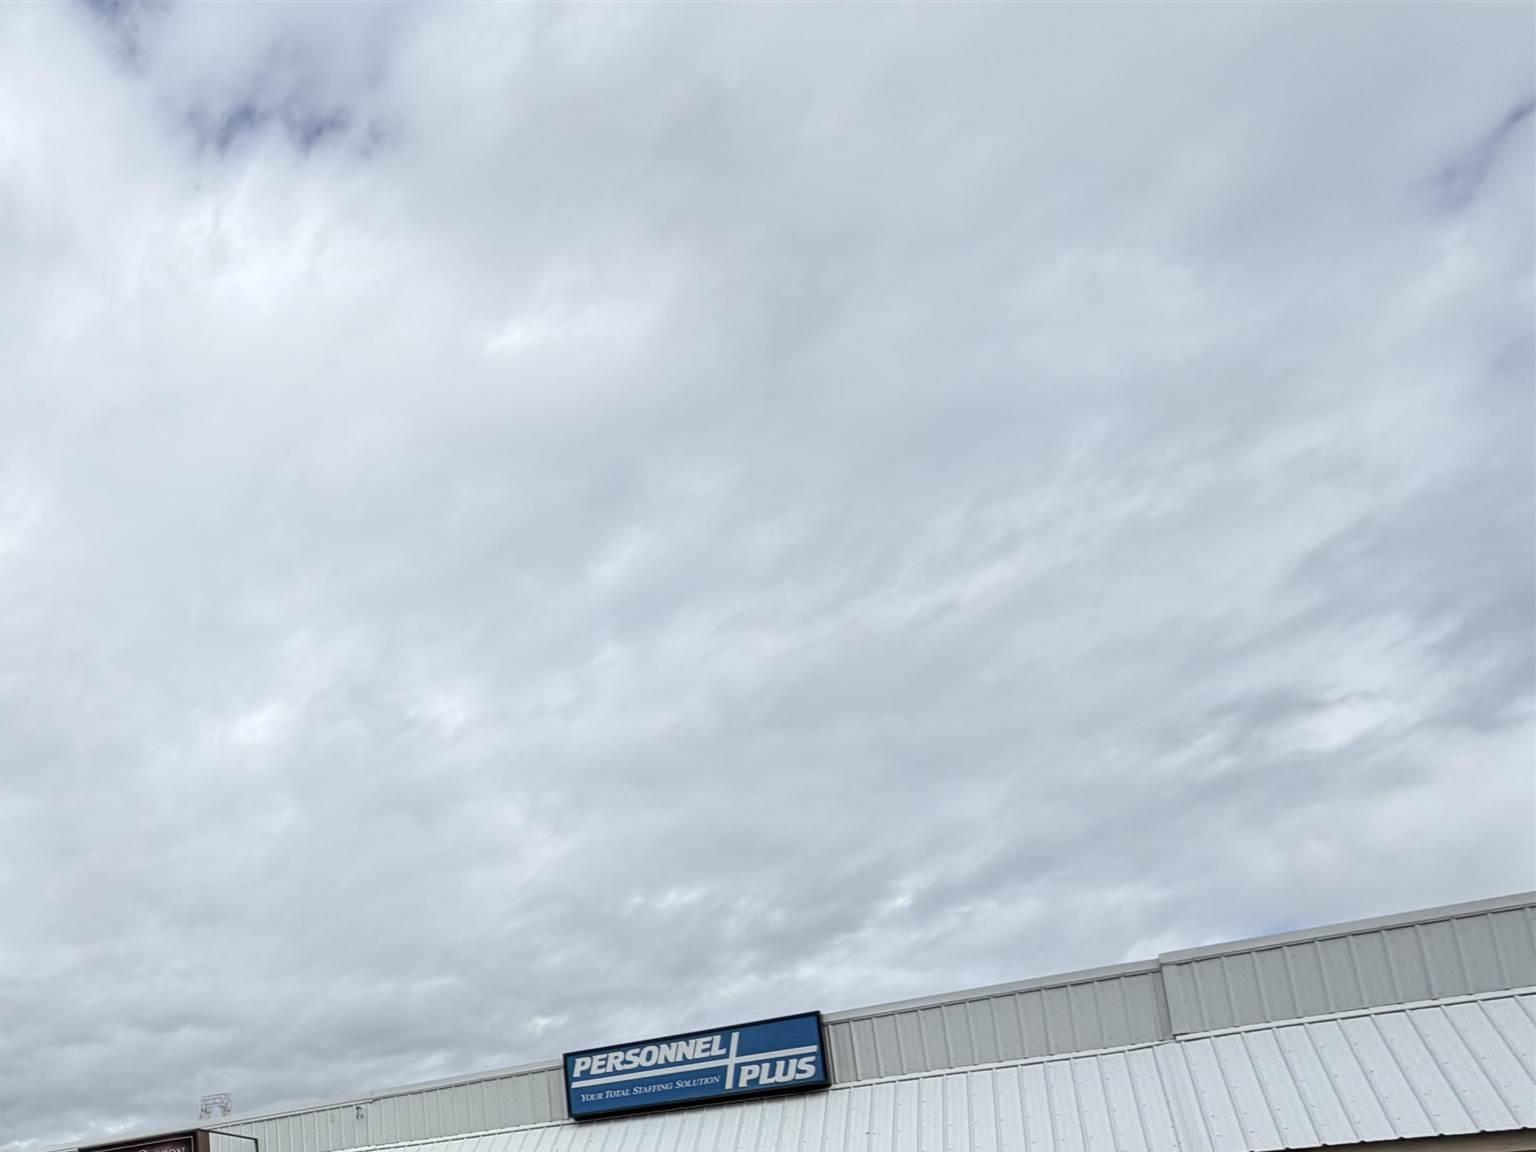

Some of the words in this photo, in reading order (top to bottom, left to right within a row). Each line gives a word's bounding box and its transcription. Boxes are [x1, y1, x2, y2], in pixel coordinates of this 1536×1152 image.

[572, 1034, 728, 1078] PERSONNEL
[738, 1055, 817, 1089] PLUS
[580, 1091, 604, 1103] YOUR
[604, 1088, 631, 1100] TOTAL
[631, 1081, 674, 1096] STAFFING
[674, 1074, 721, 1090] SOLUTION
